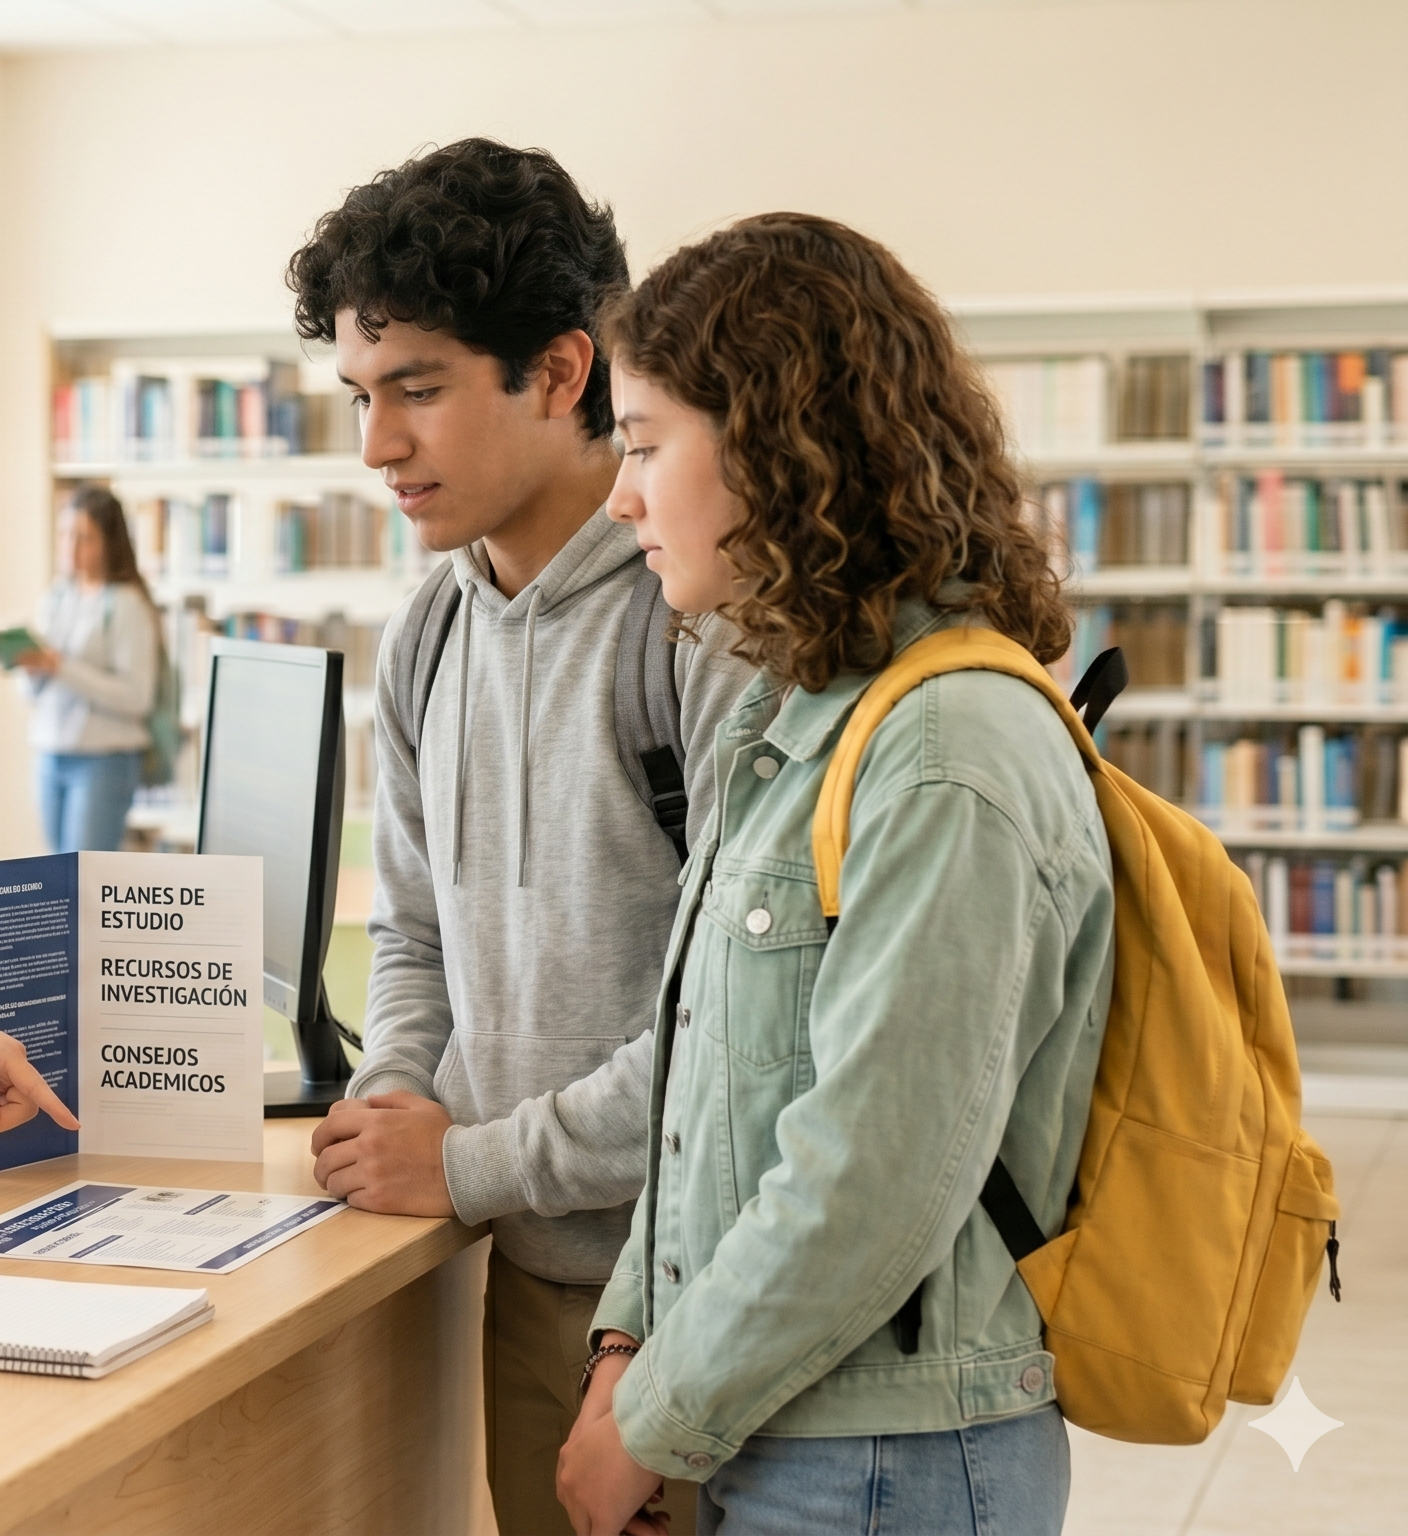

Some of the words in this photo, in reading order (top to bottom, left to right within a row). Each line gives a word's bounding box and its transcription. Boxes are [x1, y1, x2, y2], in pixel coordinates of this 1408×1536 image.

[101, 885, 174, 905] PLANES
[180, 887, 205, 906] DE
[101, 910, 184, 931] ESTUDIO
[101, 958, 202, 980] RECURSOS
[207, 962, 233, 981] DE
[101, 983, 247, 1007] INVESTIGACIÓN
[101, 1044, 199, 1067] CONSEJOS
[100, 1069, 226, 1093] ACADEMICOS
